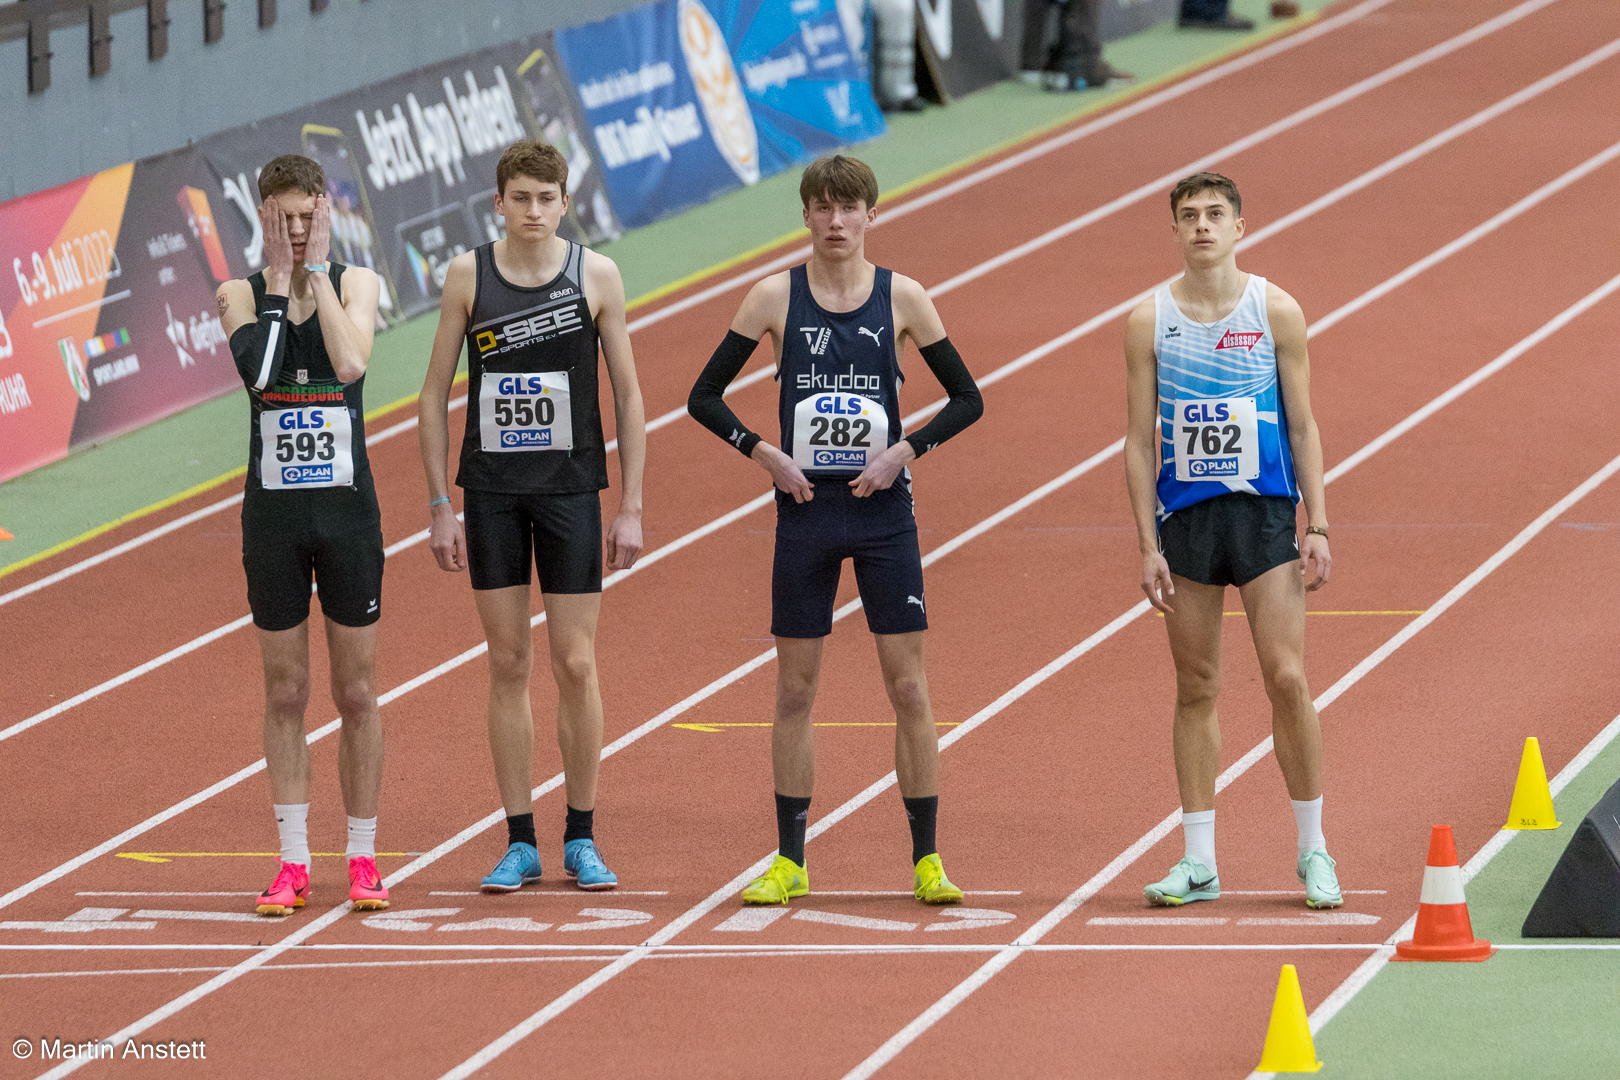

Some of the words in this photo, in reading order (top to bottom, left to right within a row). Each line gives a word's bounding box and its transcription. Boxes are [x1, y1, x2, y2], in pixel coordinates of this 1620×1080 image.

[356, 103, 424, 191] Jetzt
[406, 92, 466, 187] App
[442, 64, 526, 157] laden!
[13, 250, 57, 306] 6.-9.
[48, 240, 84, 294] Juli
[73, 229, 121, 286] 2023
[549, 287, 574, 300] eleven
[500, 335, 545, 354] SPORTS
[817, 327, 832, 355] Wetzlar
[1223, 334, 1257, 348] elsässer
[797, 363, 880, 393] skydoo
[494, 397, 555, 427] 550
[521, 432, 549, 441] PLAN
[809, 416, 871, 448] 282
[1182, 424, 1242, 455] 762
[275, 431, 336, 463] 593
[835, 452, 864, 461] PLAN
[302, 467, 331, 477] PLAN
[1208, 460, 1237, 470] PLAN
